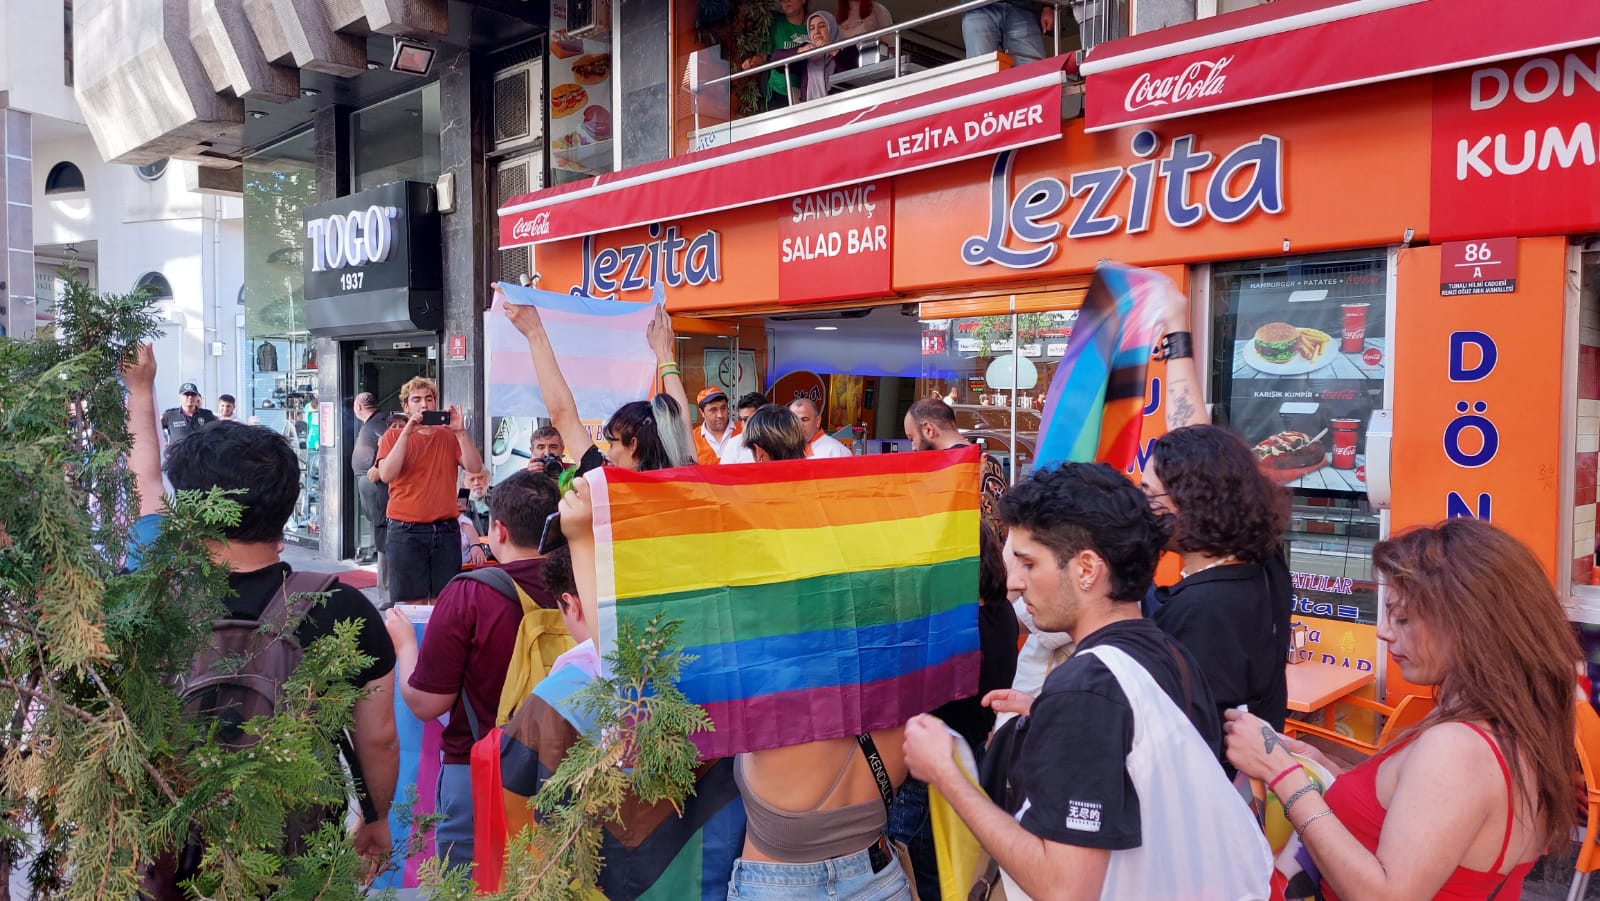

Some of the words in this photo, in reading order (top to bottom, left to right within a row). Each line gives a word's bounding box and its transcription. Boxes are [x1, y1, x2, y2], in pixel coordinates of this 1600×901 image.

[887, 127, 958, 158] LEZİTA
[965, 103, 1043, 142] DÖNER
[1456, 122, 1600, 180] KUM
[792, 183, 876, 222] SANDVİÇ
[962, 129, 1285, 269] Lezita
[307, 205, 391, 272] TOGO
[782, 235, 838, 262] SALAD
[850, 226, 887, 254] BAR
[1465, 243, 1491, 262] 86
[340, 272, 364, 290] 1937
[1250, 281, 1295, 289] HAMBURGER
[1473, 267, 1482, 278] A
[868, 752, 891, 800] KENDALL
